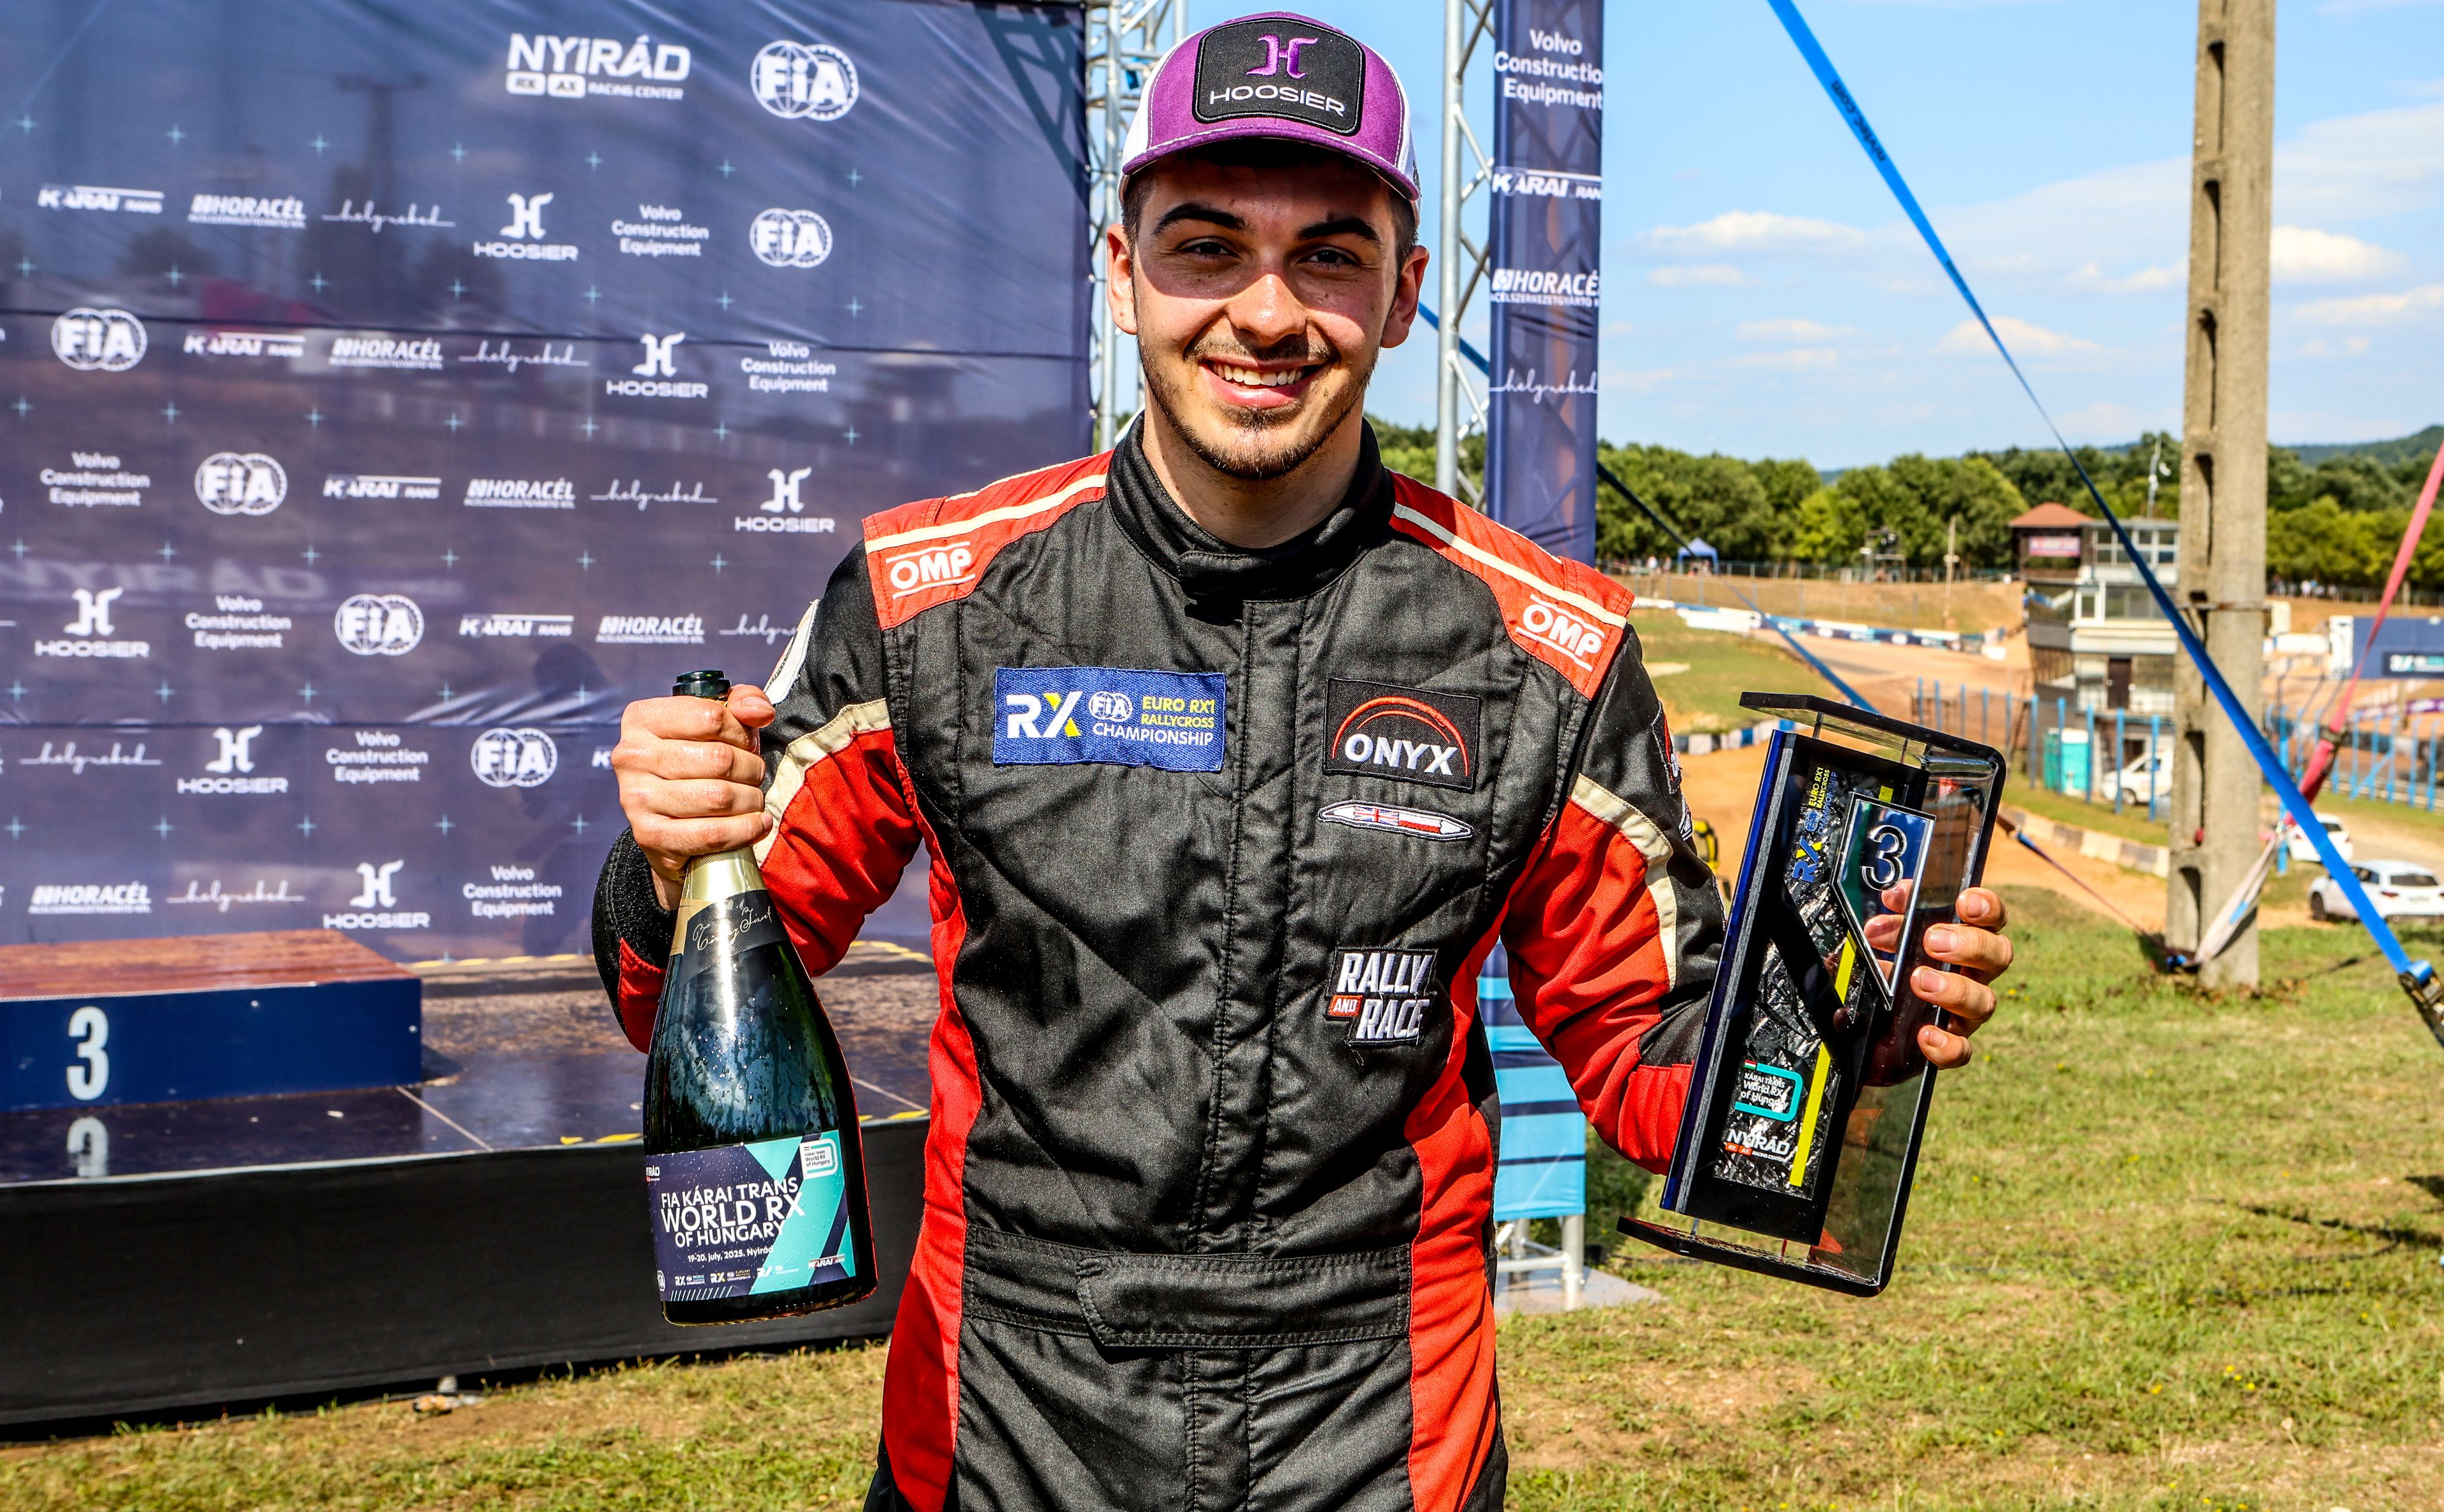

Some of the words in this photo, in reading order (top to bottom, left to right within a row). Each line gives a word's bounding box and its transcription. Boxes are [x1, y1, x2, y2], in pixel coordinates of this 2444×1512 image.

[1529, 29, 1583, 55] Volvo
[1494, 50, 1603, 85] Constructio
[1209, 85, 1347, 117] HOOSIER
[1503, 77, 1603, 110] Equipment
[213, 195, 306, 220] HORACÉL
[639, 204, 682, 221] Volvo
[611, 220, 709, 239] Construction
[474, 241, 579, 260] HOOSIER
[620, 237, 701, 256] Equipment
[1512, 269, 1599, 297] HORACÉ
[352, 337, 444, 360] HORACÉL
[768, 342, 810, 358] Volvo
[741, 357, 836, 375] Construction
[607, 380, 708, 398] HOOSIER
[749, 375, 829, 393] Equipment
[72, 451, 120, 469] Volvo
[40, 468, 150, 488] Construction
[49, 487, 141, 508] Equipment
[487, 477, 575, 500] HORACÉL
[734, 517, 835, 533] HOOSIER
[891, 548, 971, 590] OMP
[215, 595, 263, 612] Volvo
[185, 612, 292, 630] Construction
[617, 613, 705, 635] HORACÉL
[1522, 603, 1603, 658] OMP
[34, 640, 150, 659] HOOSIER
[194, 630, 283, 650] Equipment
[1142, 696, 1184, 712] EURO
[1190, 699, 1215, 713] RX1
[1006, 691, 1083, 738] RX
[1141, 713, 1214, 729] RALLYCROSS
[355, 731, 400, 747] Volvo
[1092, 723, 1213, 746] CHAMPIONSHIP
[325, 748, 428, 765] Construction
[1344, 733, 1458, 776] ONYX
[334, 766, 421, 785] Equipment
[177, 778, 288, 794] HOOSIER
[1808, 782, 1820, 806] EURO
[1814, 767, 1824, 782] RX1
[1816, 769, 1830, 809] RALLYCROSS
[1792, 836, 1823, 883] RX
[1860, 825, 1908, 892] 3
[490, 865, 535, 881] Volvo
[463, 883, 562, 899] Construction
[472, 900, 555, 919] Equipment
[323, 912, 430, 929] HOOSIER
[1337, 953, 1433, 993] RALLY
[1333, 998, 1358, 1013] AND
[1356, 999, 1430, 1039] RACE
[66, 1006, 109, 1100] 3
[1744, 1072, 1764, 1082] KÁRAI
[1741, 1091, 1752, 1099] of
[1743, 1080, 1770, 1094] World
[1771, 1086, 1783, 1096] RX
[661, 1192, 680, 1208] FIA
[682, 1186, 733, 1207] KÁRAI
[736, 1177, 798, 1200] TRANS
[661, 1200, 757, 1233] WORLD
[766, 1191, 806, 1221] RX
[675, 1231, 694, 1248] OF
[697, 1219, 786, 1247] HUNGARY
[687, 1254, 707, 1263] 19-20.
[724, 1249, 745, 1259] 2025.
[675, 1275, 686, 1286] RX
[710, 1272, 726, 1284] RX
